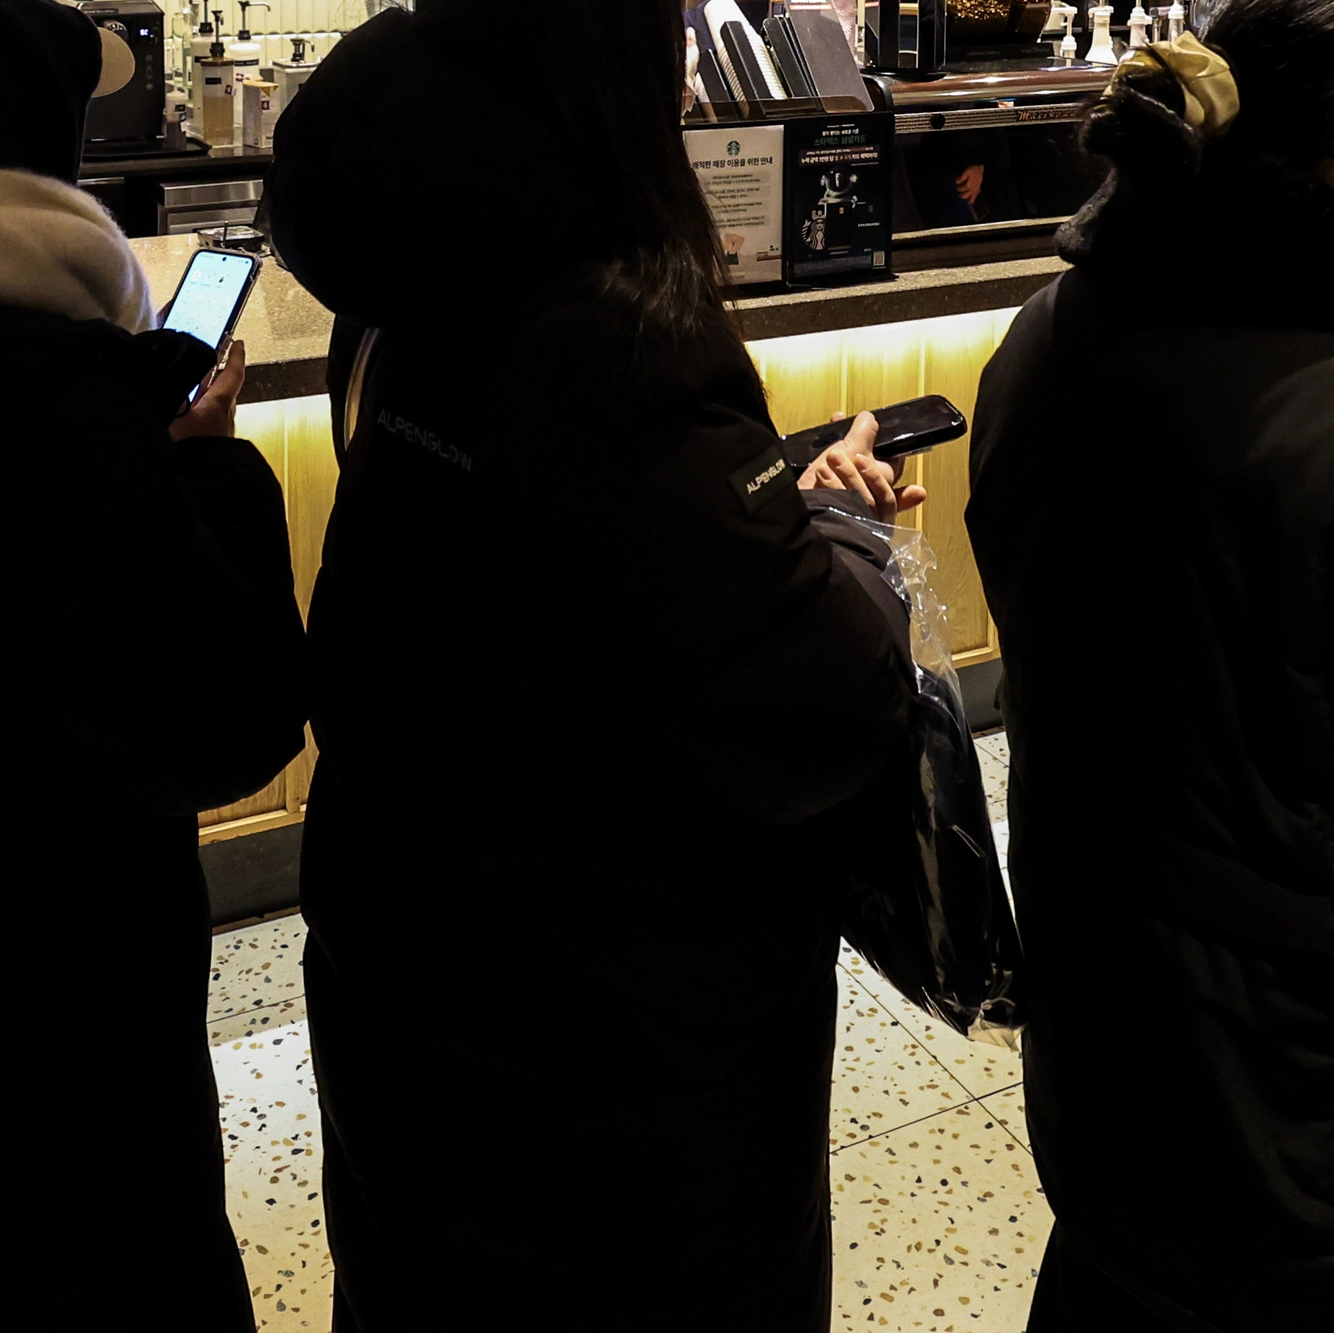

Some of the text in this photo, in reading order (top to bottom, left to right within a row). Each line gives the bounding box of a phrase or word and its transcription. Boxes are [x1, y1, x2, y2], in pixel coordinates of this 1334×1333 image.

[726, 158, 746, 167] 이용을
[747, 157, 760, 166] 위한
[760, 156, 773, 166] 안내
[377, 408, 473, 472] ALPENGLOW
[746, 458, 786, 495] ALPENGLOW
